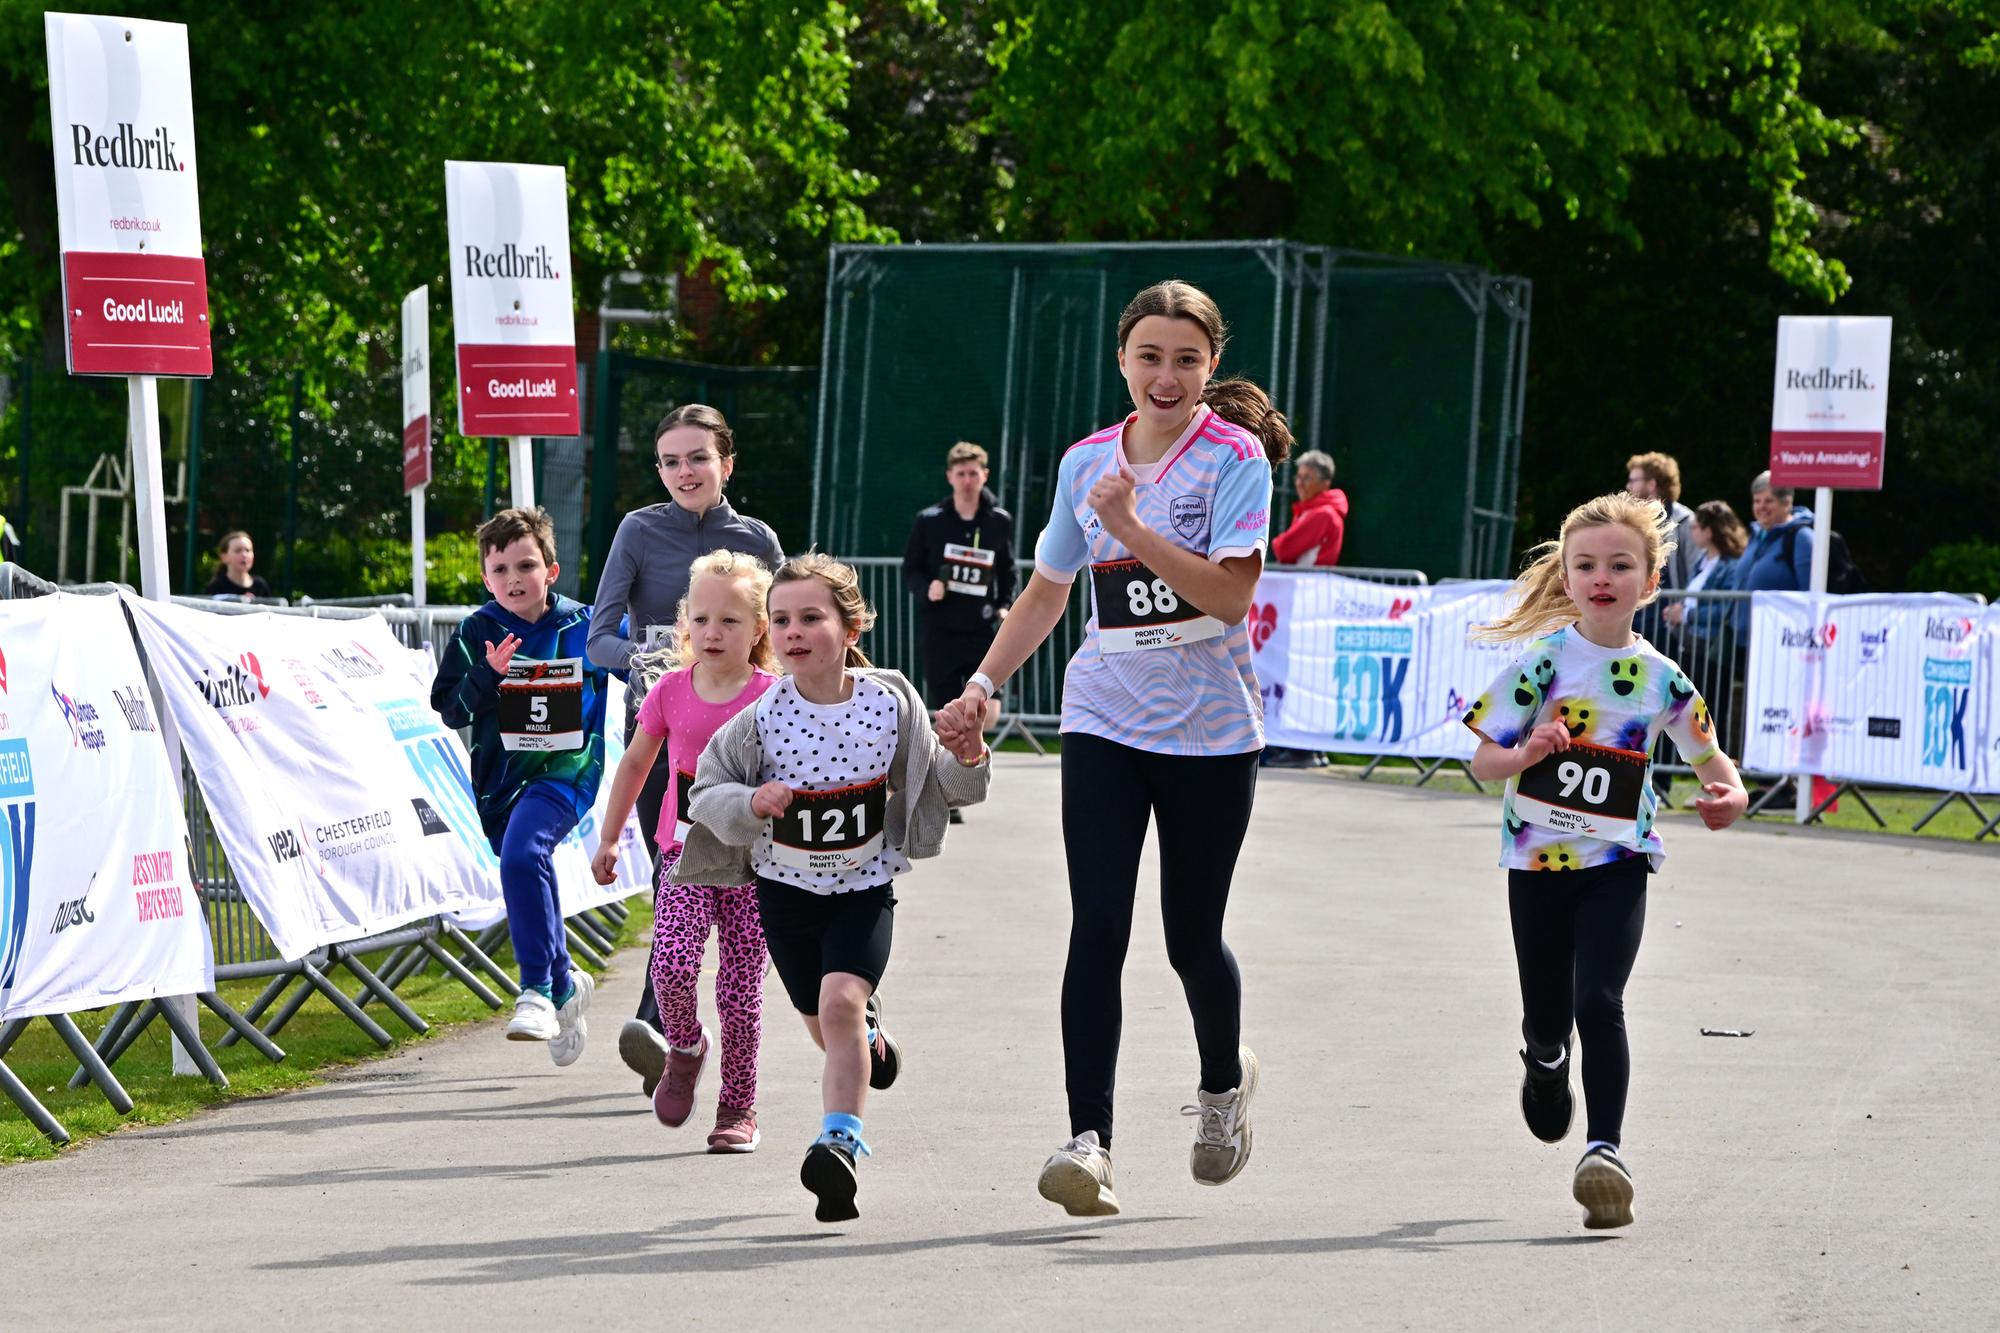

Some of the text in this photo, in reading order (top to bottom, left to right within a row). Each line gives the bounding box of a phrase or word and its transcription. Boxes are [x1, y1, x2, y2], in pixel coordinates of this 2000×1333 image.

[71, 123, 184, 172] Redbrik.
[110, 217, 161, 232] redbrik.co.uk
[465, 243, 560, 279] Redbrik.
[103, 298, 184, 324] Good Luck!
[488, 379, 557, 398] Good Luck!
[1786, 367, 1876, 391] Redbrik.
[1780, 450, 1871, 469] You're Amazing!
[1174, 502, 1201, 511] Arsenal
[952, 565, 981, 583] 113
[1126, 577, 1178, 616] 88
[1134, 628, 1166, 638] PRONTO
[1136, 638, 1162, 647] PAINTS
[530, 696, 548, 723] 5
[1333, 656, 1410, 743] 10K
[525, 724, 551, 732] WADDLE
[1923, 684, 1969, 770] 10K
[1557, 761, 1611, 805] 90
[316, 811, 392, 843] CHESTERFIELD
[797, 803, 866, 842] 121
[1548, 817, 1576, 830] PAINTS
[1550, 809, 1583, 822] PRONTO
[318, 832, 396, 862] BOROUGH COUNCIL
